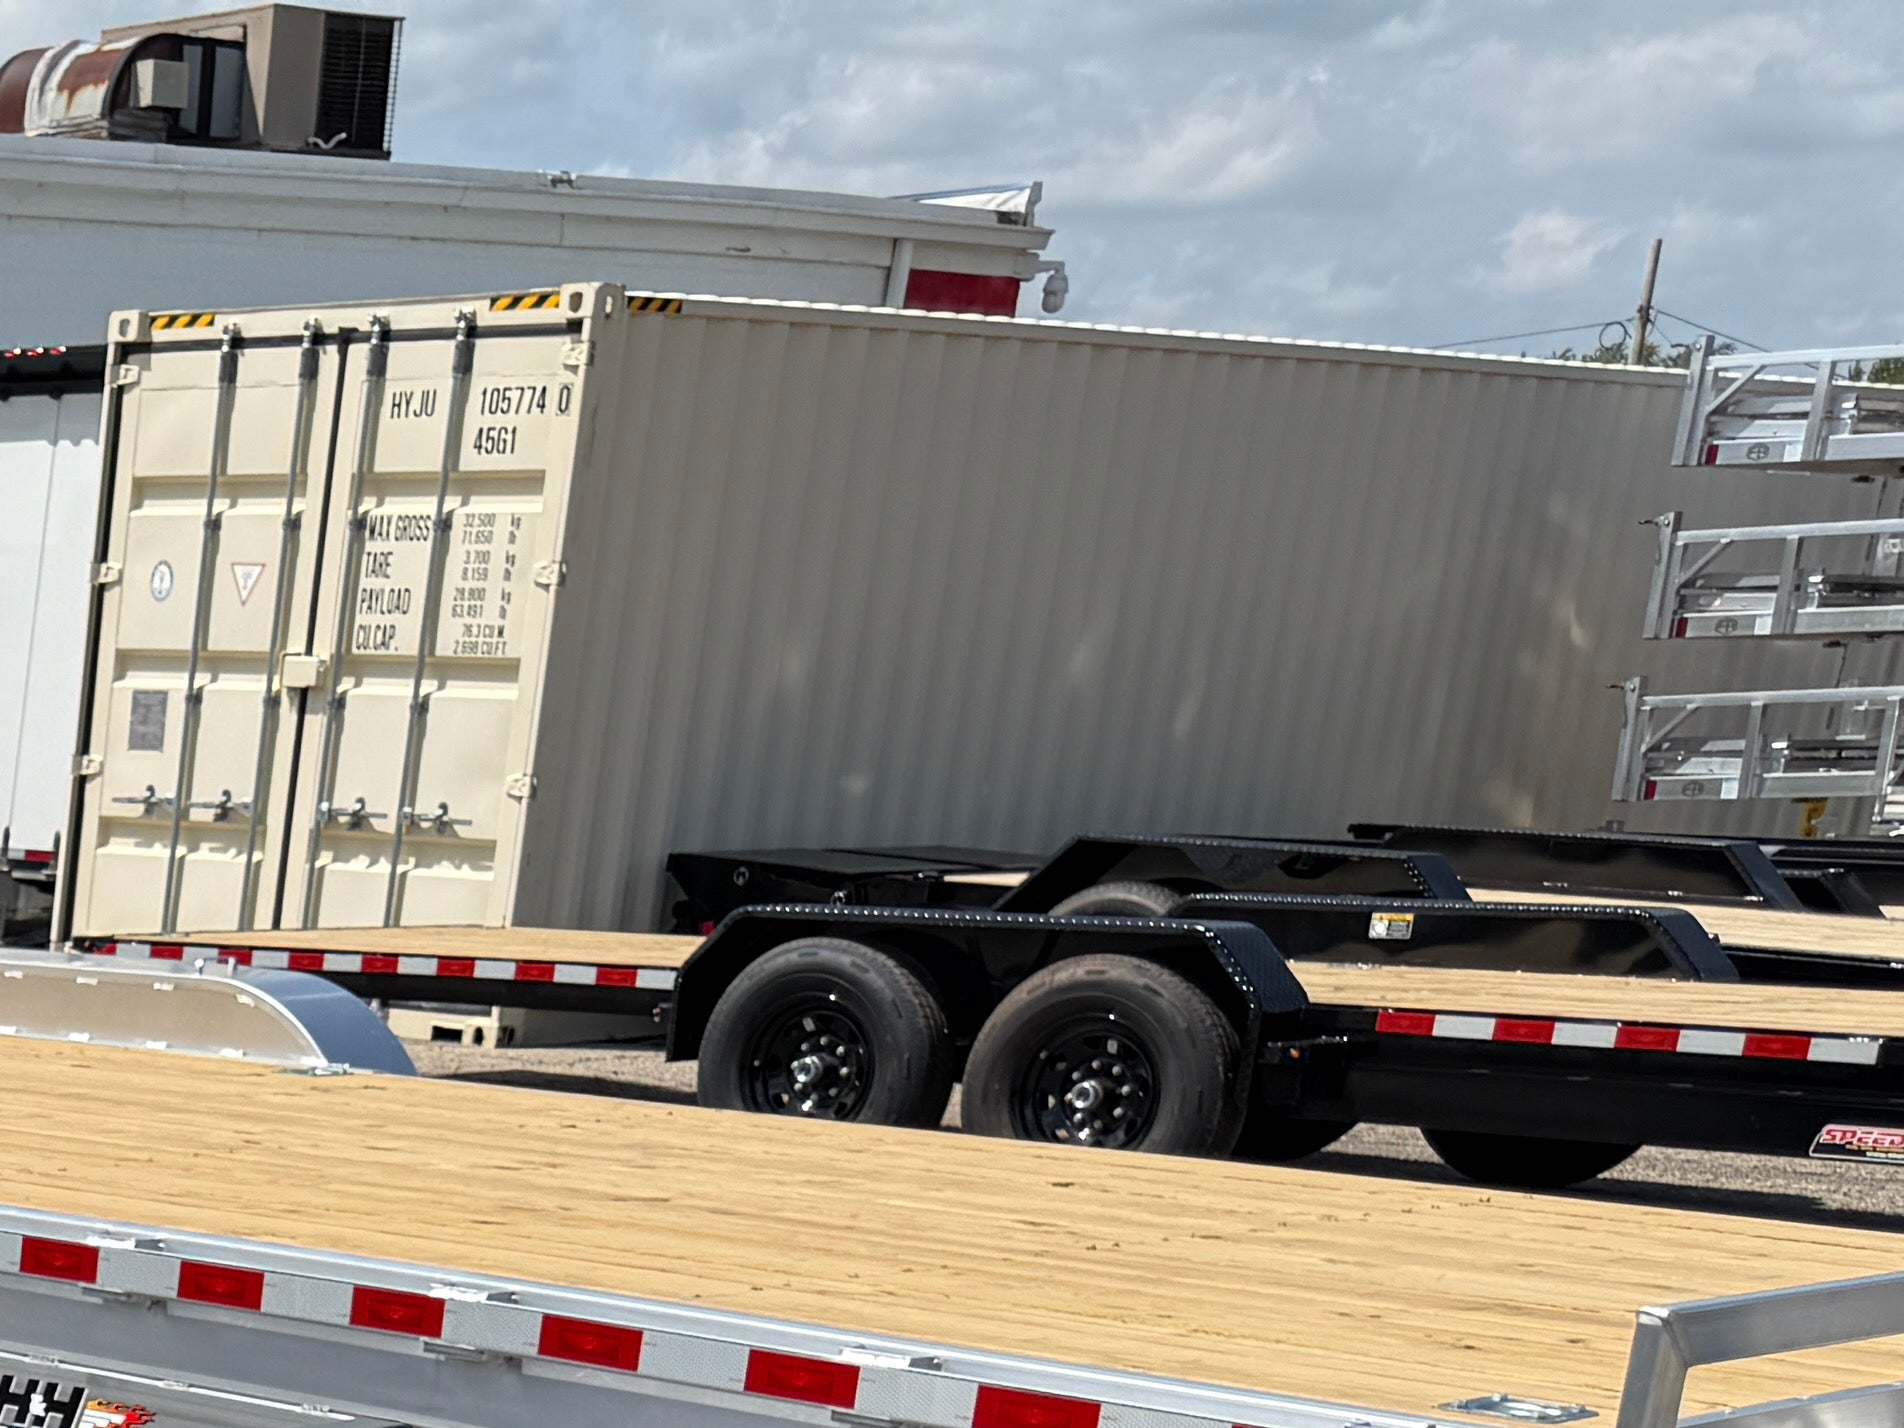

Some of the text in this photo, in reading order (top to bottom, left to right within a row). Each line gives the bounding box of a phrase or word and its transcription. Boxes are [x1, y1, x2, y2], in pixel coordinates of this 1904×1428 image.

[390, 383, 573, 419] HYJU 105774 0
[473, 425, 518, 455] 45G1
[366, 514, 433, 542] MAX GROSS
[365, 551, 393, 579] TARE
[358, 587, 412, 616] PAYLOAD
